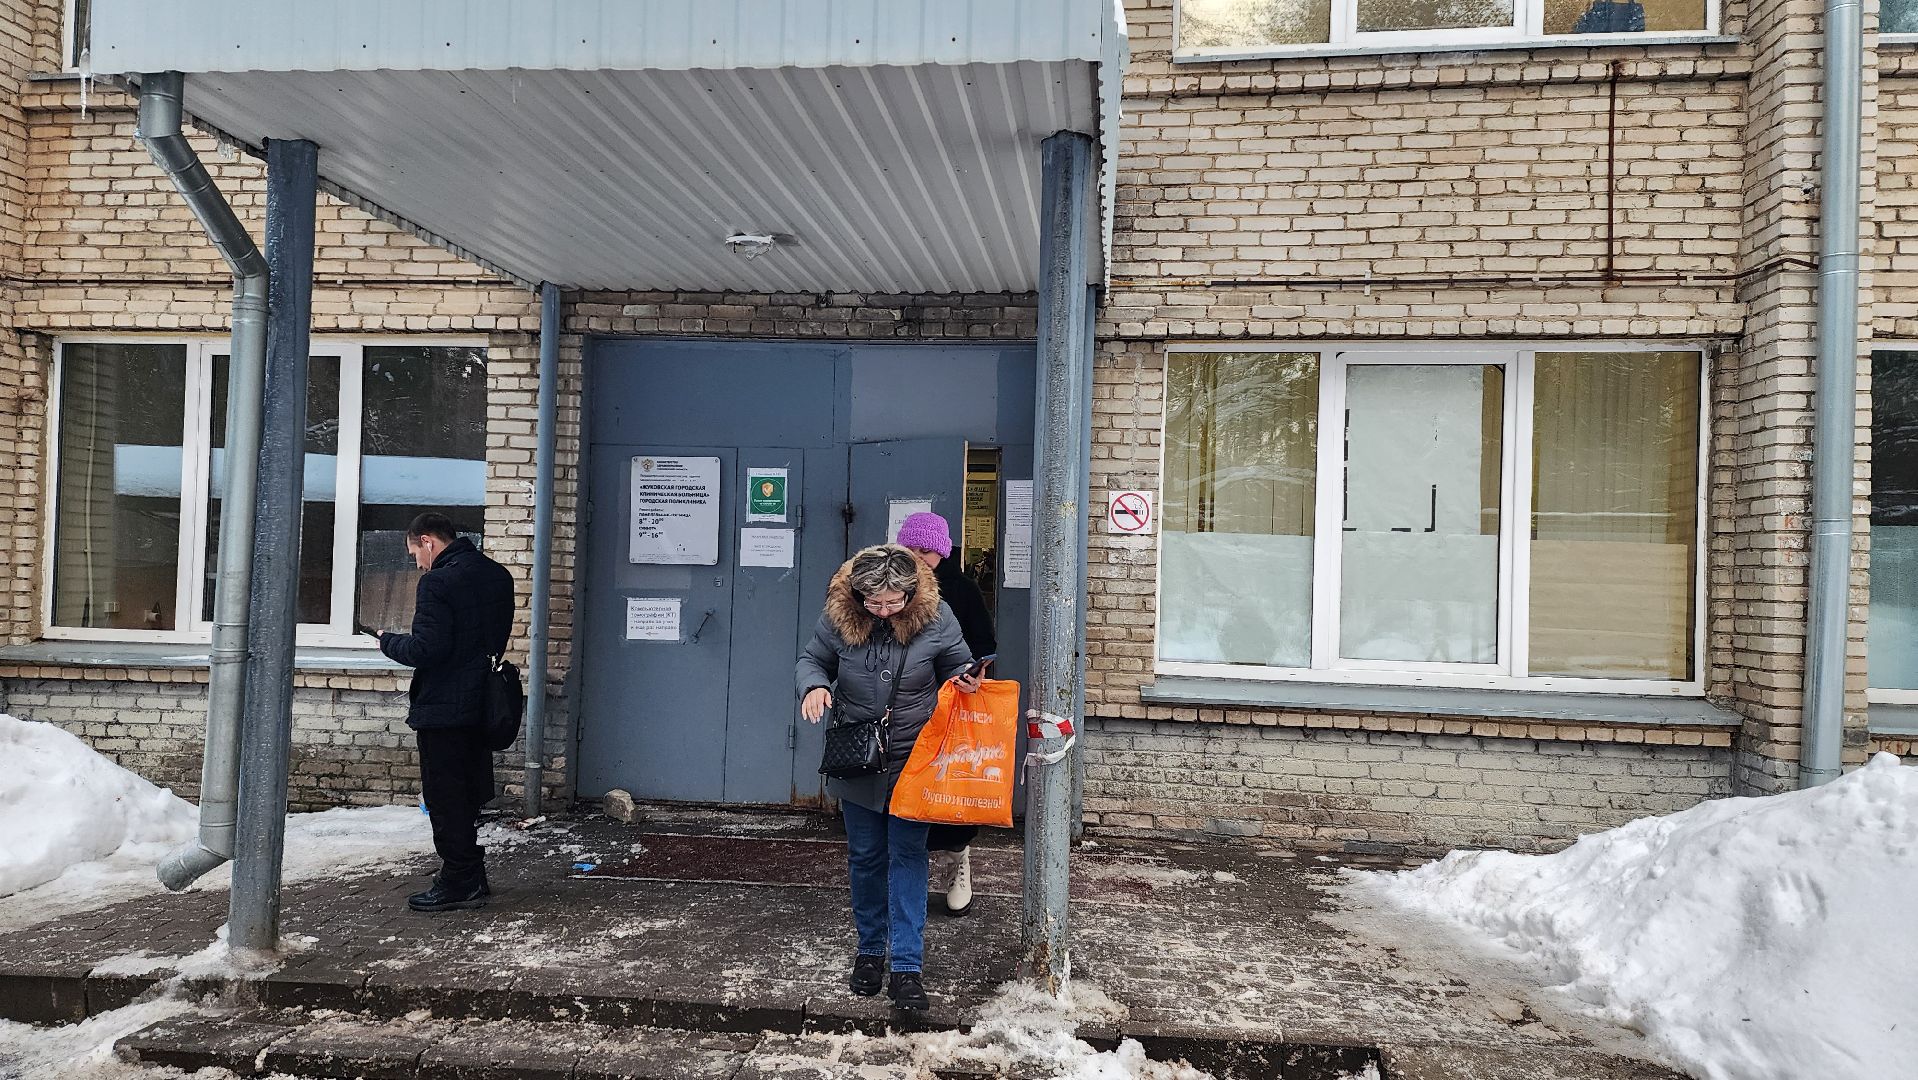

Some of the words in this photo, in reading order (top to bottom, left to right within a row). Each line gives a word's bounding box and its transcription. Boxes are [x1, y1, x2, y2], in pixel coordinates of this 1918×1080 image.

[922, 787, 951, 803] Вкусно
[952, 795, 960, 805] и
[960, 795, 1002, 809] полезно!
